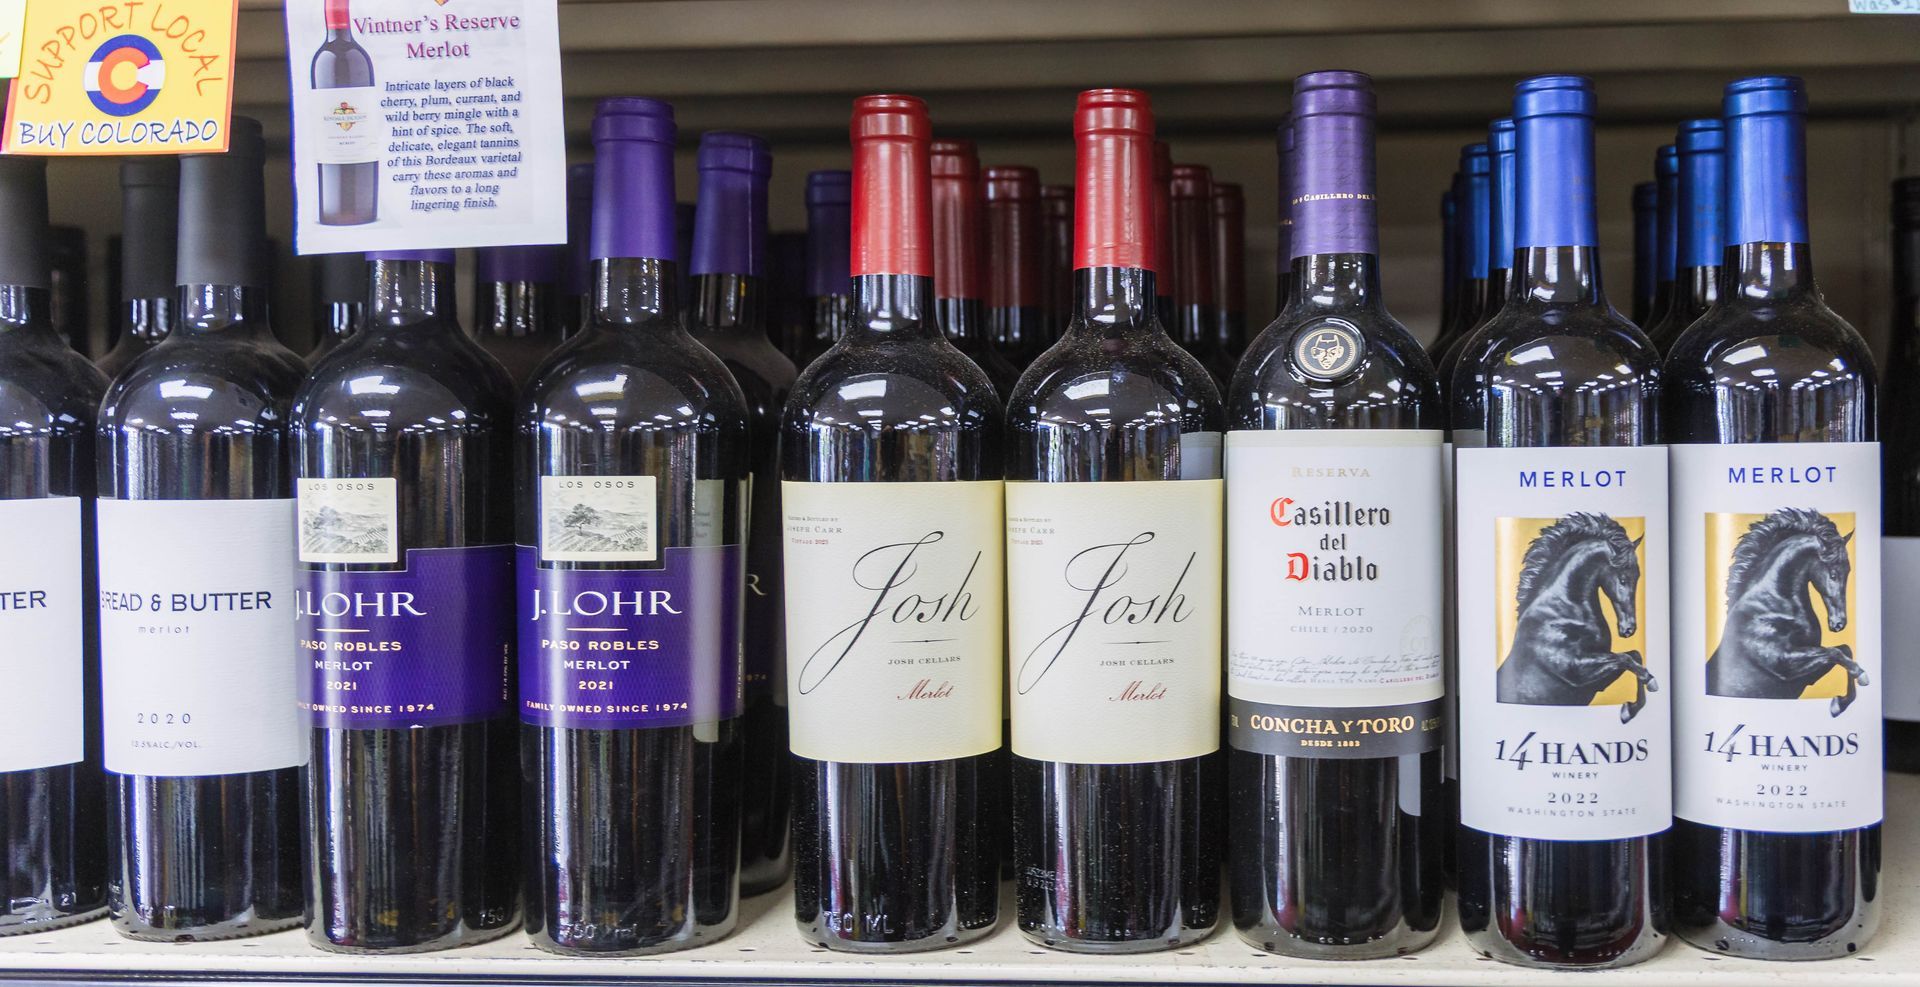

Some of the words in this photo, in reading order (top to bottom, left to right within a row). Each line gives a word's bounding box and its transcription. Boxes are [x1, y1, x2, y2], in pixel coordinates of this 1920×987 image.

[353, 15, 439, 34] Vintner's
[444, 13, 520, 31] Reserve
[24, 1, 144, 104] SUPPORT
[151, 3, 223, 97] LOCAL
[406, 41, 470, 59] Merlot
[384, 80, 431, 93] Intricate
[434, 79, 466, 94] layers
[470, 78, 484, 88] of
[485, 76, 514, 88] black
[380, 96, 417, 109] cherry,
[421, 95, 452, 107] plum,
[455, 93, 498, 105] currant,
[501, 91, 521, 102] and
[385, 110, 409, 122] wild
[412, 108, 440, 123] berry
[444, 107, 482, 122] mingle
[485, 106, 509, 118] with
[512, 109, 519, 117] a
[20, 122, 74, 148] BUY
[81, 119, 218, 145] COLORADO
[391, 126, 413, 137] hint
[416, 125, 430, 136] of
[431, 125, 462, 138] spice.
[466, 123, 487, 134] The
[489, 122, 513, 134] soft,
[388, 142, 434, 152] delicate,
[437, 140, 477, 152] elegant
[480, 137, 519, 148] tannins
[387, 157, 400, 167] of
[402, 156, 422, 167] this
[425, 155, 477, 166] Bordeaux
[481, 152, 522, 163] varietal
[392, 172, 420, 183] carry
[424, 170, 451, 180] these
[454, 170, 493, 179] aromas
[497, 167, 518, 177] and
[410, 185, 448, 196] flavors
[451, 185, 462, 194] to
[465, 186, 471, 194] a
[475, 183, 499, 195] long
[410, 199, 459, 212] lingering
[463, 197, 497, 208] finish.
[1519, 470, 1627, 488] MERLOT
[1728, 466, 1837, 484] MERLOT
[308, 483, 329, 491] LOS
[336, 482, 375, 491] OSOS
[559, 480, 583, 489] LOS
[594, 480, 635, 489] OSOS
[1270, 497, 1392, 527] Casillero
[1320, 533, 1346, 551] del
[1284, 552, 1379, 582] Diablo
[0, 590, 47, 610] TER
[150, 594, 162, 611] &
[171, 591, 272, 612] BUTTER
[799, 530, 982, 695] Josh
[1017, 531, 1196, 695] Josh
[138, 625, 190, 634] merlot
[1342, 625, 1373, 634] 2020
[300, 639, 327, 650] PASO
[334, 641, 402, 652] ROBLES
[541, 639, 580, 650] PASO
[588, 640, 660, 650] ROBLES
[315, 660, 373, 672] MERLOT
[563, 660, 631, 670] MERLOT
[887, 658, 914, 666] JOSH
[918, 656, 961, 665] CELLARS
[1100, 659, 1126, 667] JOSH
[1129, 657, 1174, 667] CELLARS
[326, 681, 357, 691] 2021
[578, 680, 613, 690] 2021
[897, 679, 954, 701] Merlot
[1108, 680, 1168, 702] Merlot
[312, 703, 347, 713] OWNED
[351, 705, 392, 714] SINCE
[399, 703, 435, 713] 1974
[526, 700, 555, 711] FAMILY
[559, 703, 601, 713] OWNED
[607, 703, 649, 713] SINCE
[655, 702, 688, 712] 1974
[137, 712, 191, 724] 2020
[1250, 714, 1339, 736] CONCHA
[1341, 720, 1354, 733] Y
[1356, 715, 1415, 734] TORO
[1300, 739, 1333, 747] DESDE
[1703, 723, 1746, 762] 14
[1748, 732, 1859, 758] HANDS
[1495, 731, 1537, 771] 14
[1539, 739, 1649, 765] HANDS
[1552, 771, 1599, 780] WINERY
[1761, 764, 1808, 772] WINERY
[1756, 784, 1808, 796] 2022
[1547, 792, 1599, 804] 2022
[1716, 797, 1804, 810] WASHINGTON
[1812, 800, 1847, 810] STATE
[1507, 806, 1595, 817] WASHINGTON
[1602, 806, 1637, 817] STATE
